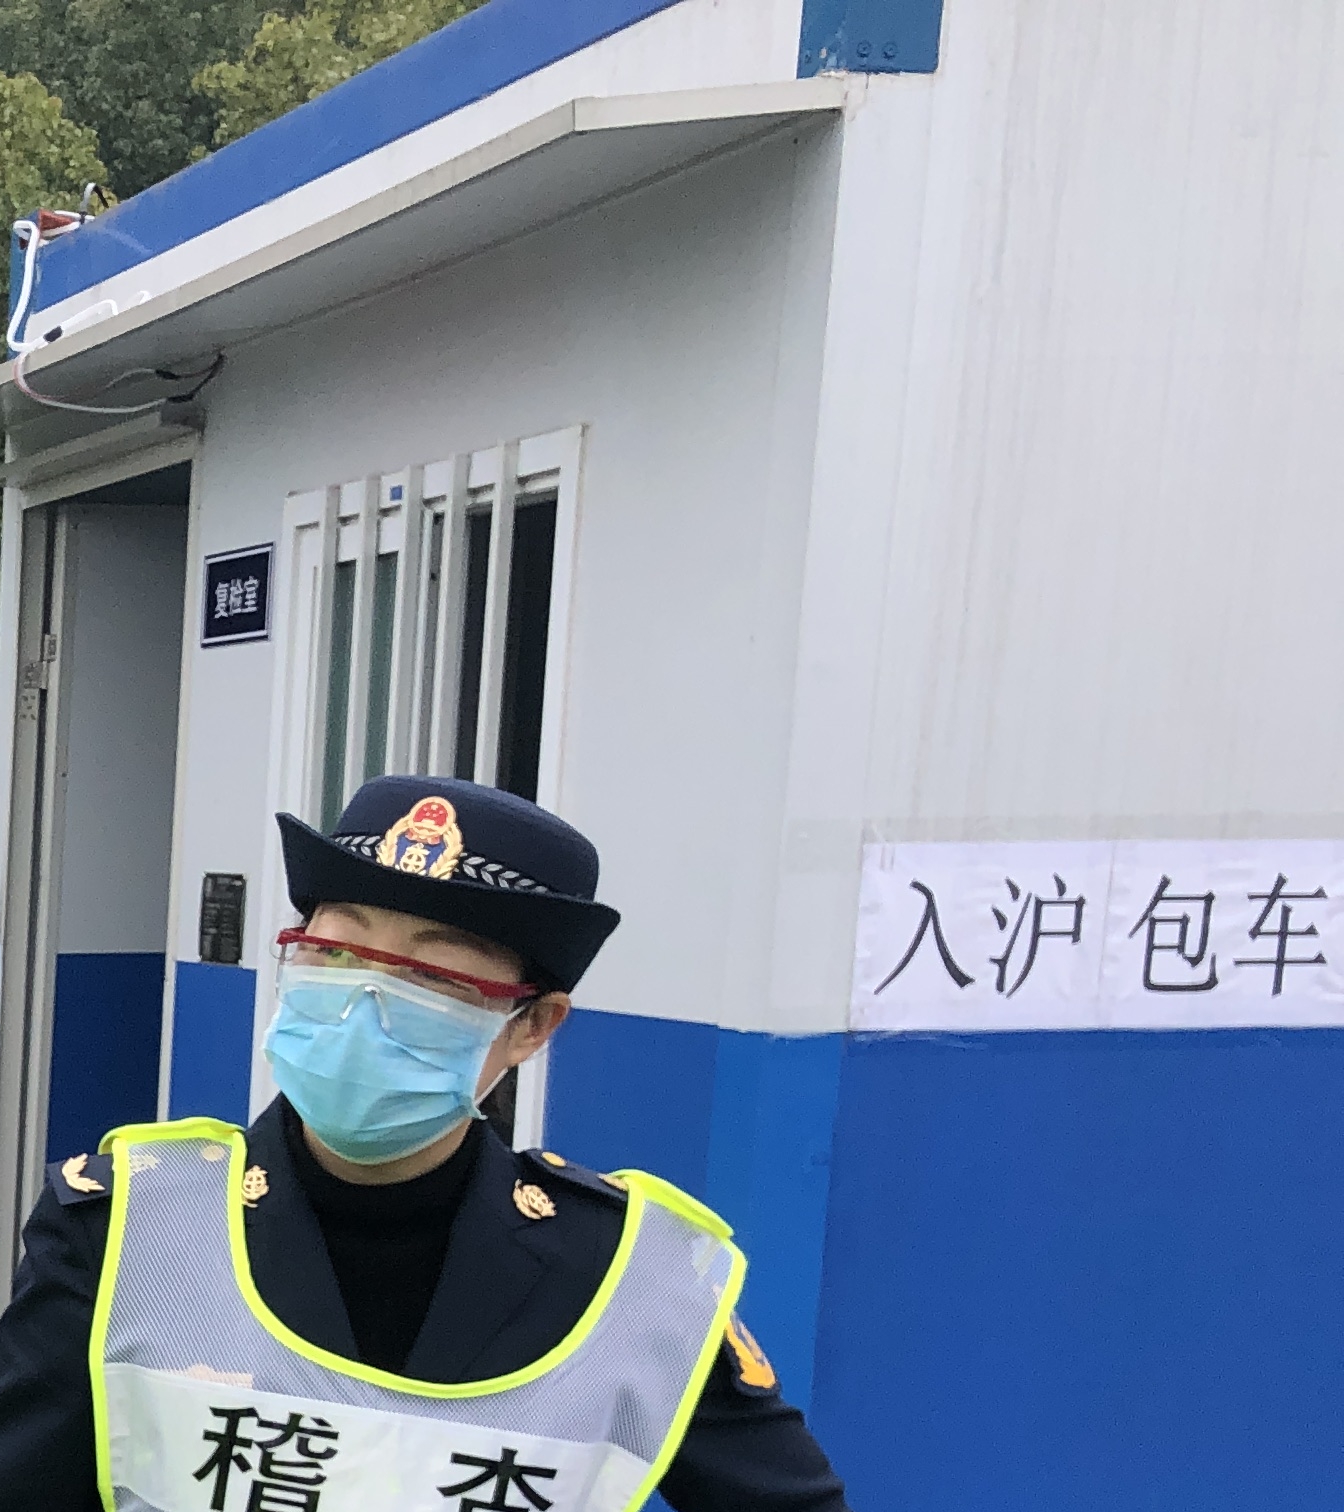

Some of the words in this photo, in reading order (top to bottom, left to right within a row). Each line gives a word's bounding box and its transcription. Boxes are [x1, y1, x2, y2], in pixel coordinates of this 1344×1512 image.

[214, 575, 259, 619] 复检室
[873, 872, 1327, 999] 入沪包车
